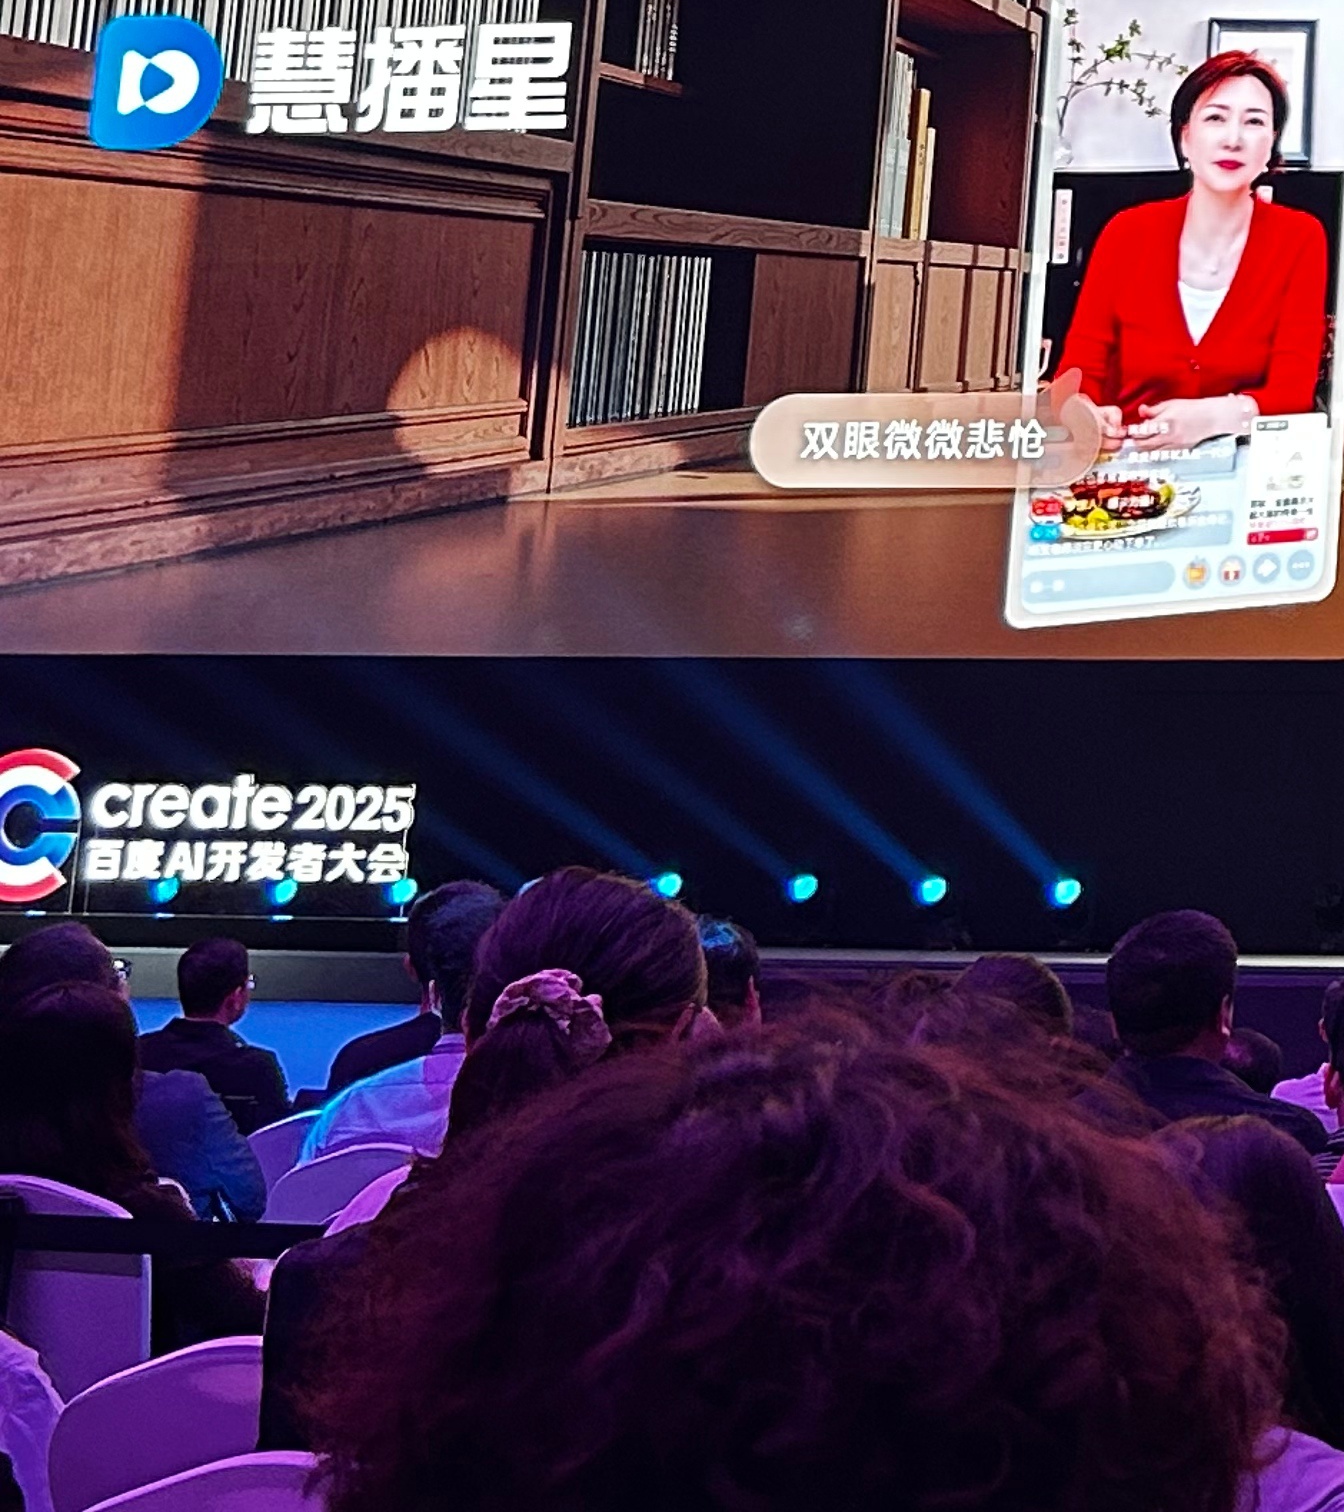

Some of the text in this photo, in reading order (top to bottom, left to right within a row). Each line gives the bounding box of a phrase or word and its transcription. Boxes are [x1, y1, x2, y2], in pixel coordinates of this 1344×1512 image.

[246, 21, 573, 135] 慧播星
[799, 418, 1048, 461] 双眼微微悲怆
[90, 774, 416, 833] create 2025
[86, 838, 409, 884] 百度AI开发者大会
